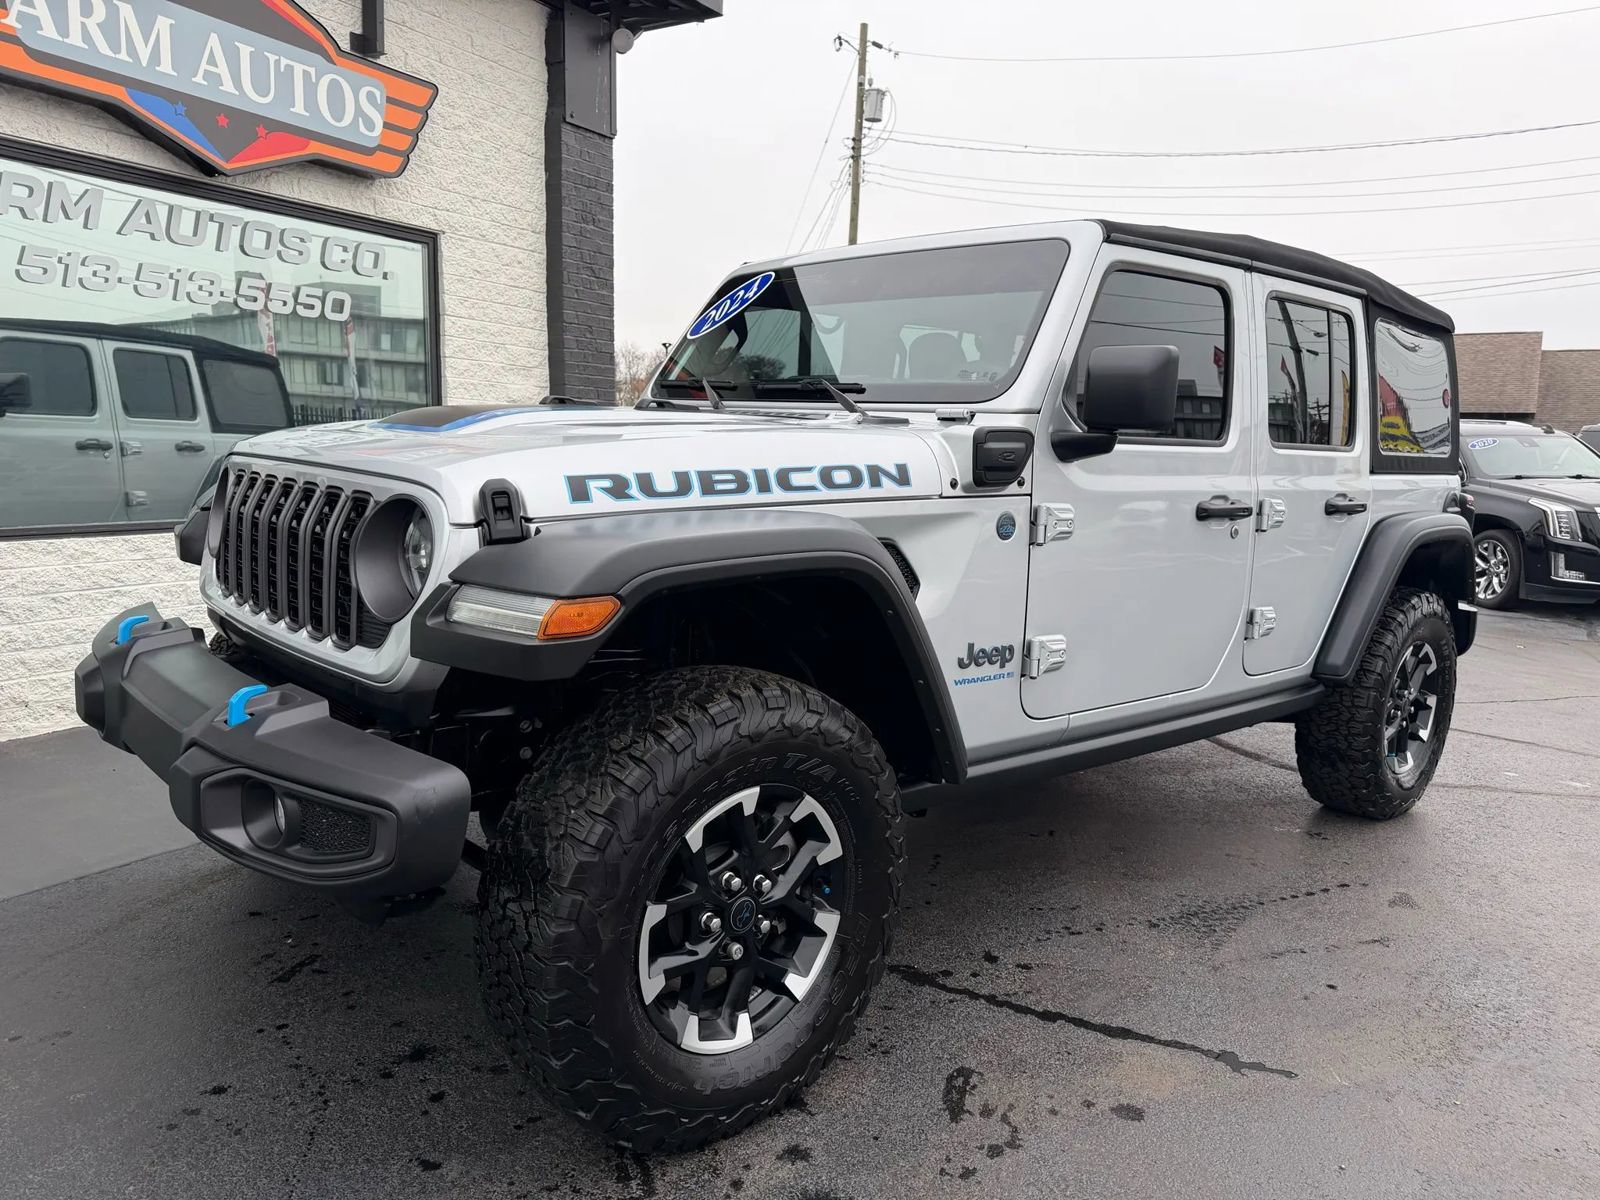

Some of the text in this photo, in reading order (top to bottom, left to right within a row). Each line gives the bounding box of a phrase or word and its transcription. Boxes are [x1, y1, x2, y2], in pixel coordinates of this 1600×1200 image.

[192, 32, 384, 138] AUTOS
[117, 198, 312, 265] AUTOS
[321, 236, 393, 280] CO.
[14, 245, 352, 322] 513-513-5550
[700, 276, 762, 333] 2024
[564, 463, 912, 504] RUBICON
[954, 673, 1006, 687] WRANGLER
[957, 642, 1015, 670] Jeep
